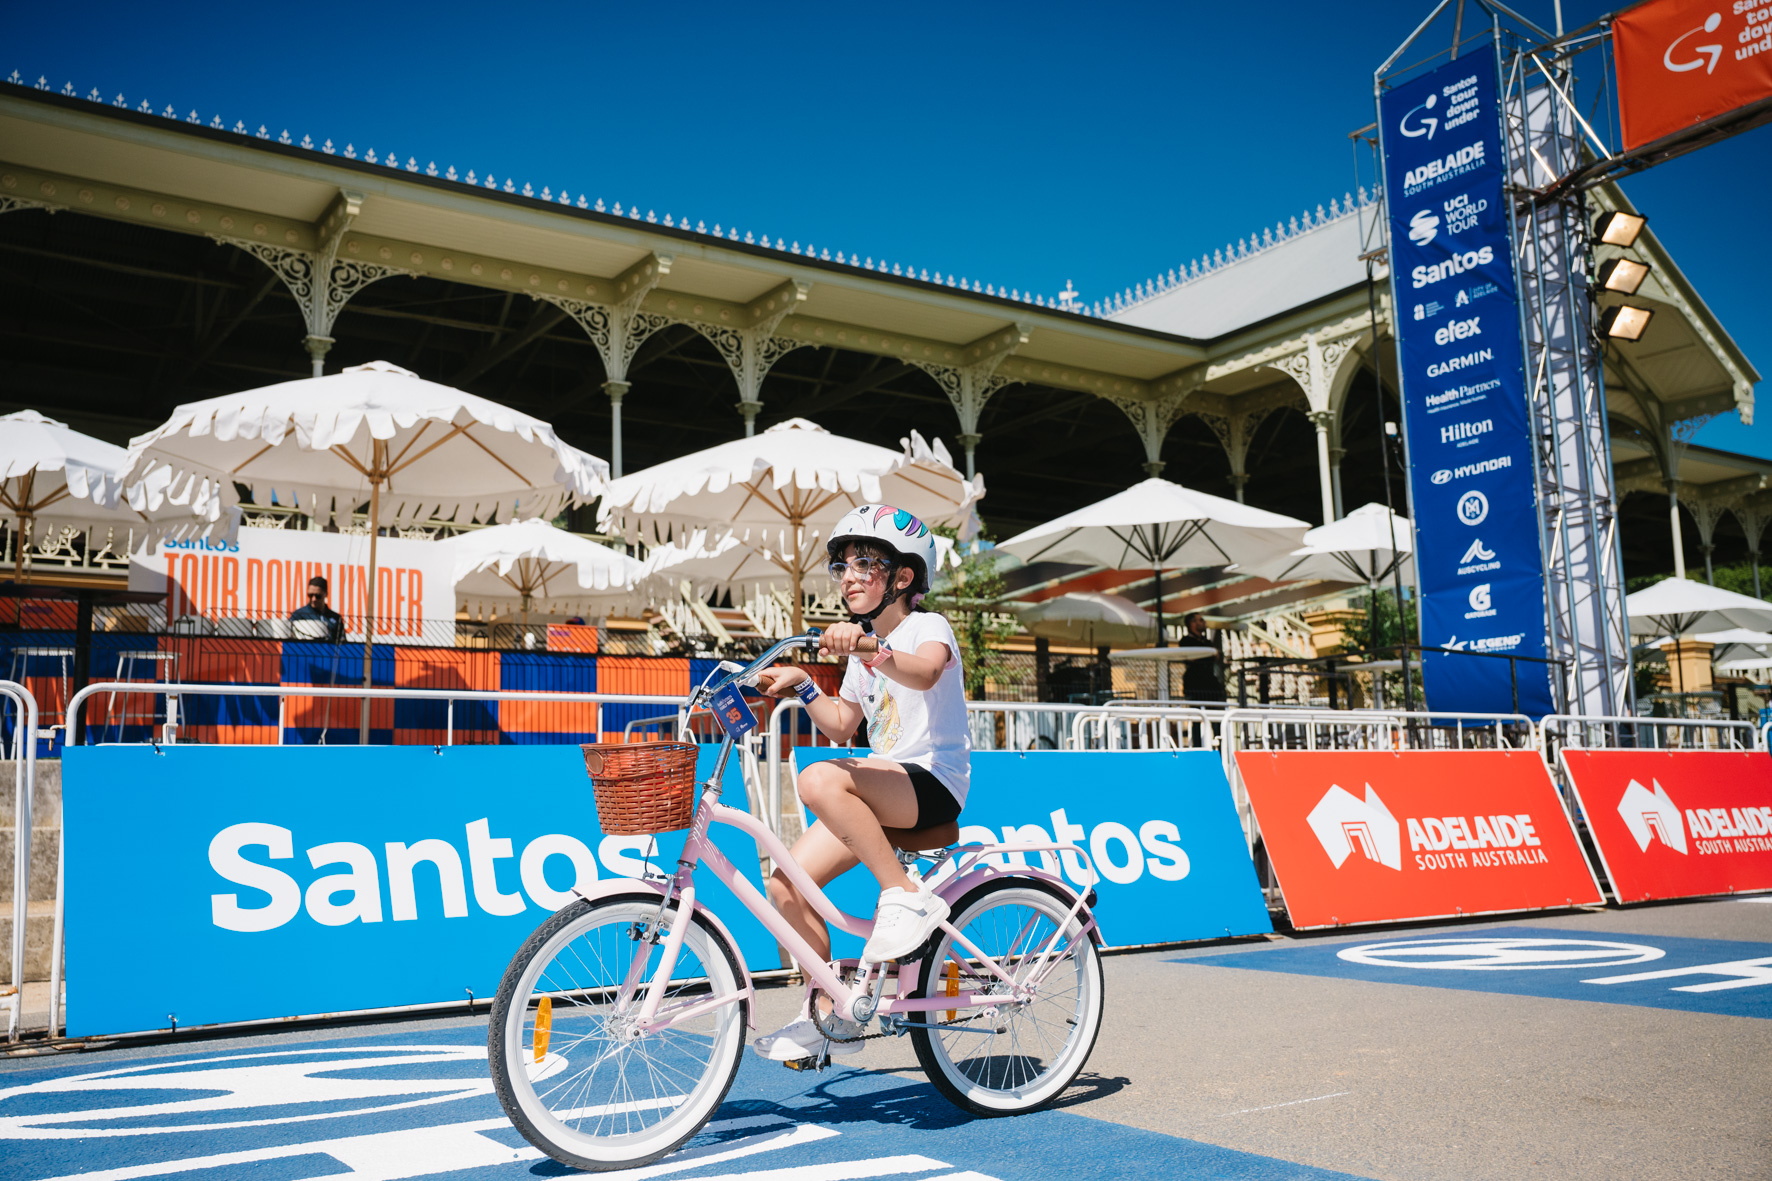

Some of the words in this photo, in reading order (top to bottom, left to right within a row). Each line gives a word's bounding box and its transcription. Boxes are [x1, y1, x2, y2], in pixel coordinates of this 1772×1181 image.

[1443, 75, 1478, 97] Santos
[1451, 86, 1478, 105] tour
[1444, 108, 1480, 131] under
[1446, 97, 1479, 118] down
[1404, 140, 1485, 189] ADELAIDE
[1404, 180, 1434, 198] SOUTH
[1436, 158, 1486, 181] AUSTRALIA
[1444, 193, 1468, 212] UCI
[1445, 199, 1487, 223] WORLD
[1446, 214, 1478, 235] TOUR
[1411, 246, 1494, 289] Santos
[1435, 316, 1481, 346] efex
[1426, 347, 1492, 378] GARMIN
[1426, 388, 1460, 408] Health
[1459, 378, 1501, 398] Partners
[1440, 419, 1493, 444] Hilton
[1454, 455, 1512, 479] HYUNDAI
[164, 552, 239, 627] TOUR
[339, 564, 422, 637] UNDER
[726, 707, 742, 724] 35
[1406, 814, 1541, 851] ADELAIDE
[1685, 806, 1772, 839] ADELAIDE
[925, 808, 1190, 886] antos
[1415, 852, 1467, 871] SOUTH
[1471, 848, 1549, 867] AUSTRALIA
[1695, 839, 1733, 855] SOUTH
[208, 817, 668, 932] Santos
